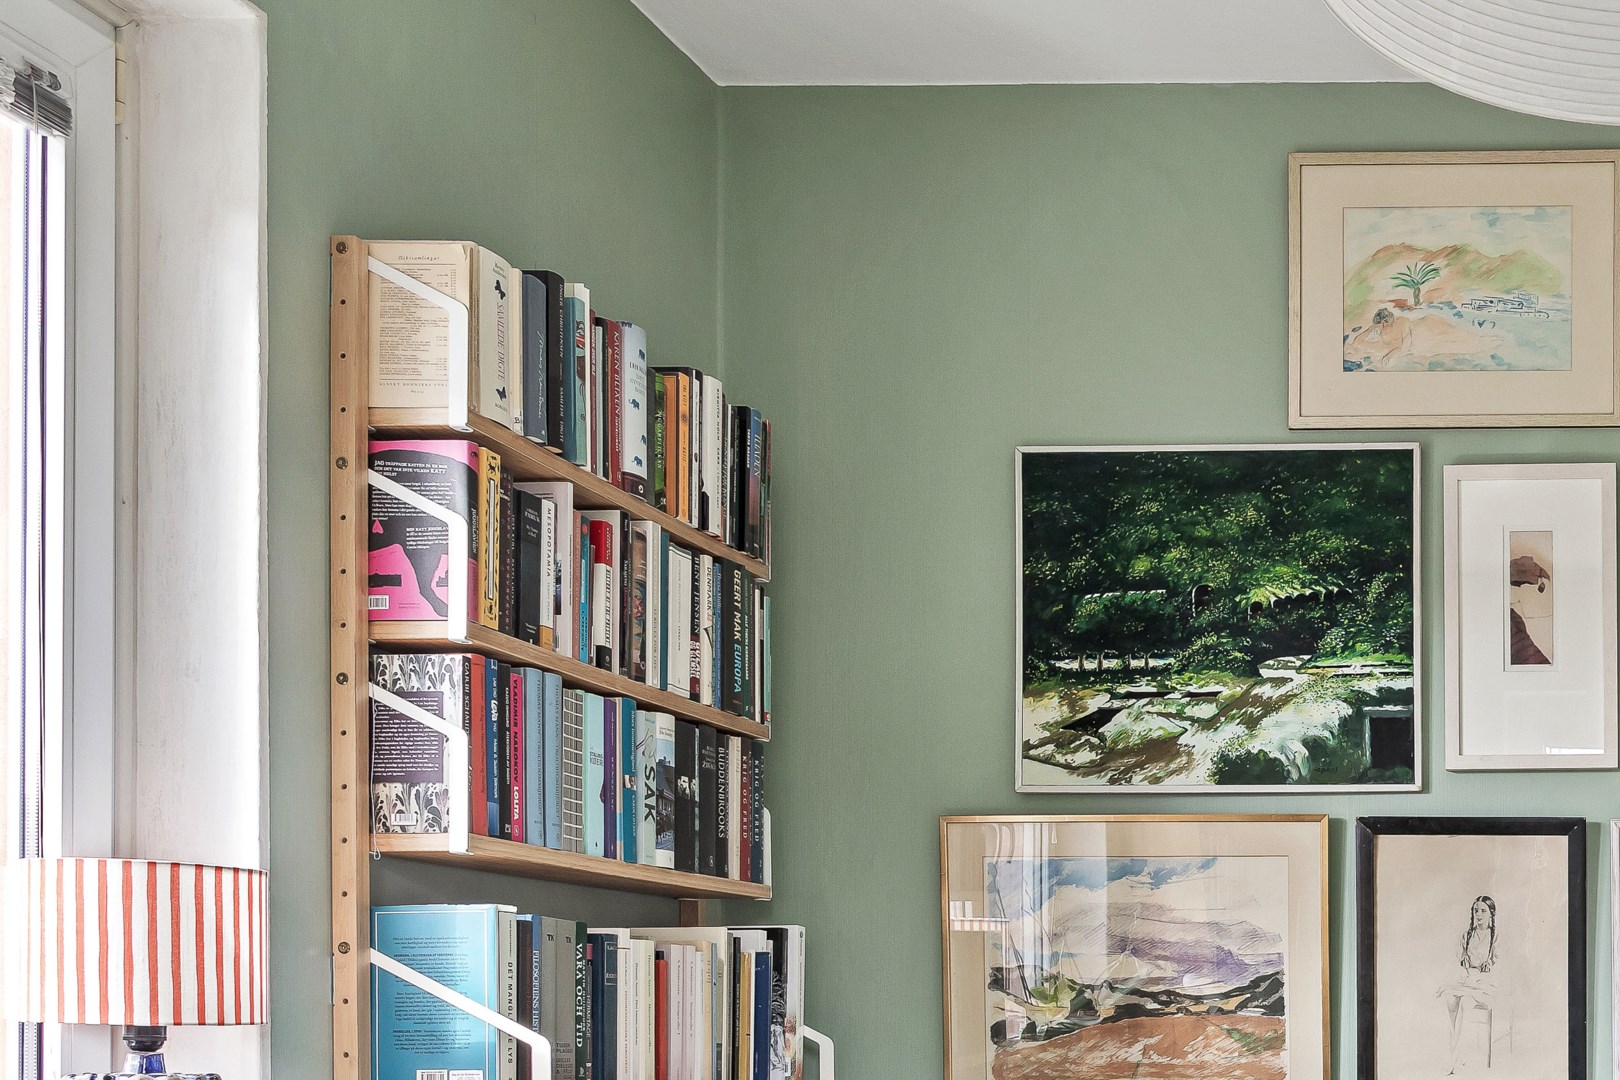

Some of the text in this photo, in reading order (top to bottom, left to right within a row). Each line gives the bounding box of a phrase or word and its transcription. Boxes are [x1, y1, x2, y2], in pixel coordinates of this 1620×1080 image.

[497, 302, 505, 381] SAMLEDE DIGTE
[733, 569, 742, 693] GEERT MAK EUROPA
[644, 764, 656, 824] SAK
